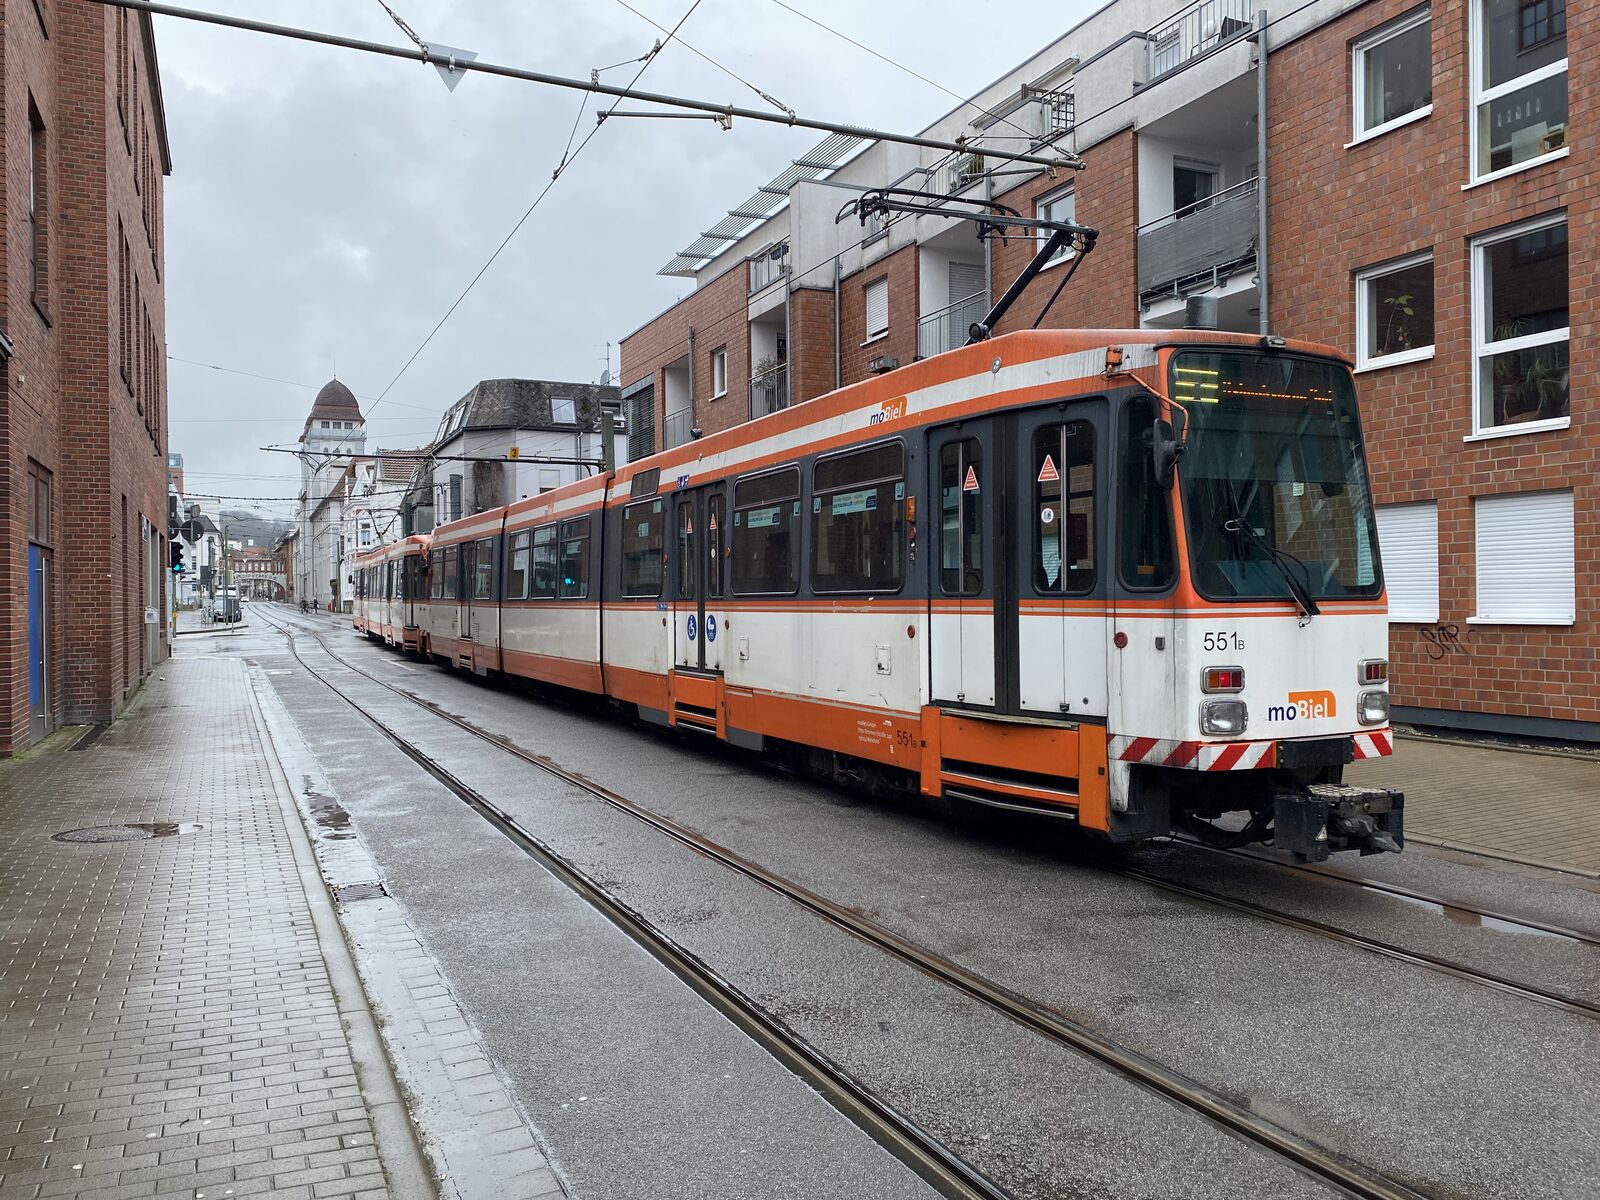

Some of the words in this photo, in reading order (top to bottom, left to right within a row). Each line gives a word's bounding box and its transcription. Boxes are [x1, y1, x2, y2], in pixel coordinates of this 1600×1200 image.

[870, 401, 903, 426] moBiel
[511, 448, 517, 458] 3
[1268, 697, 1328, 722] moBiel
